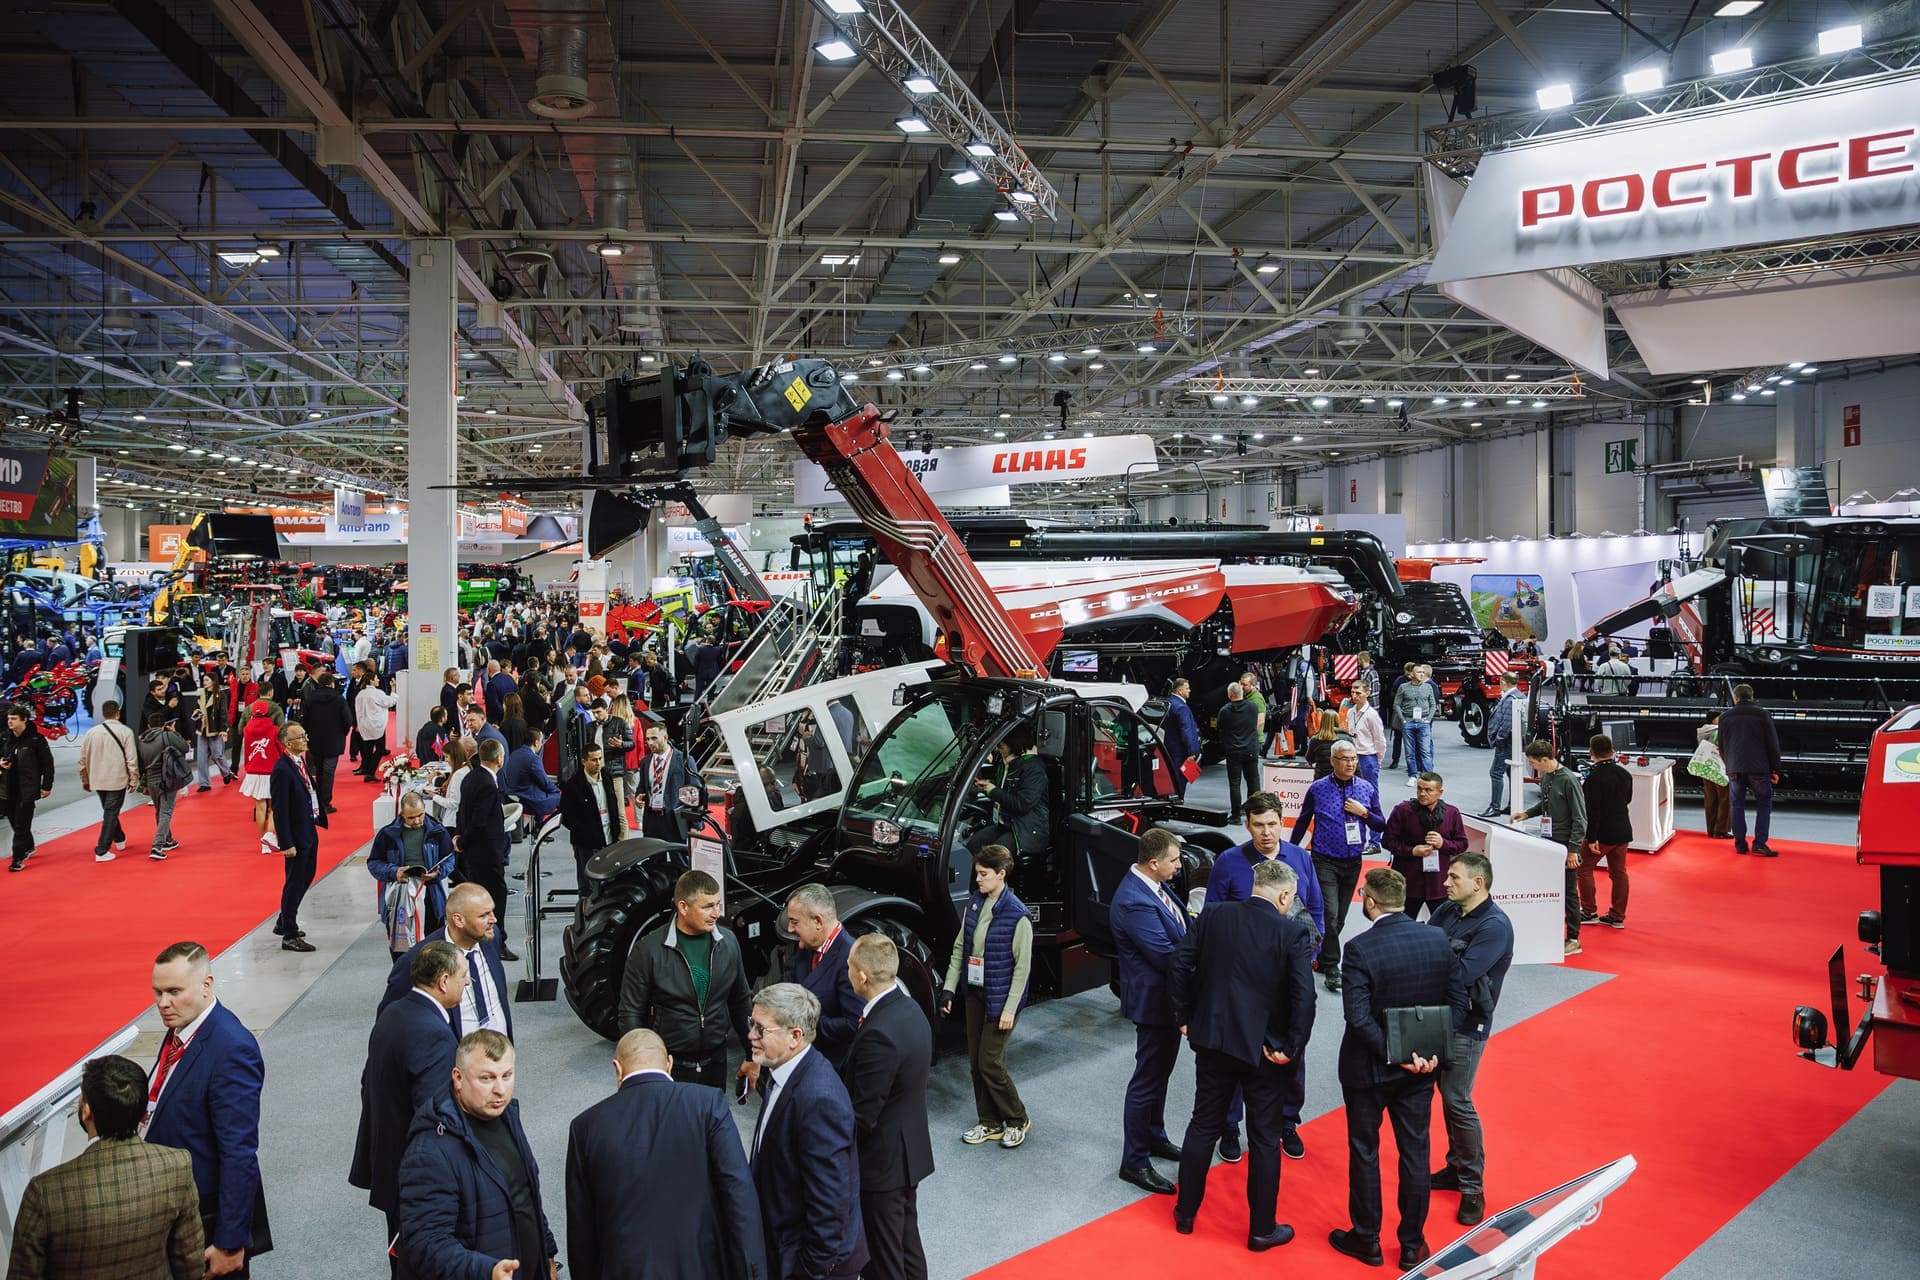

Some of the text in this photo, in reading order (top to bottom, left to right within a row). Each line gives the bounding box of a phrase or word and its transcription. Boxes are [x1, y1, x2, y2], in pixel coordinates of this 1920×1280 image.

[1521, 128, 1915, 228] РОСТСЕ
[992, 448, 1087, 473] CLAAS
[686, 531, 738, 541] LEEN
[1852, 653, 1920, 662] РОСТСЕЛЬ
